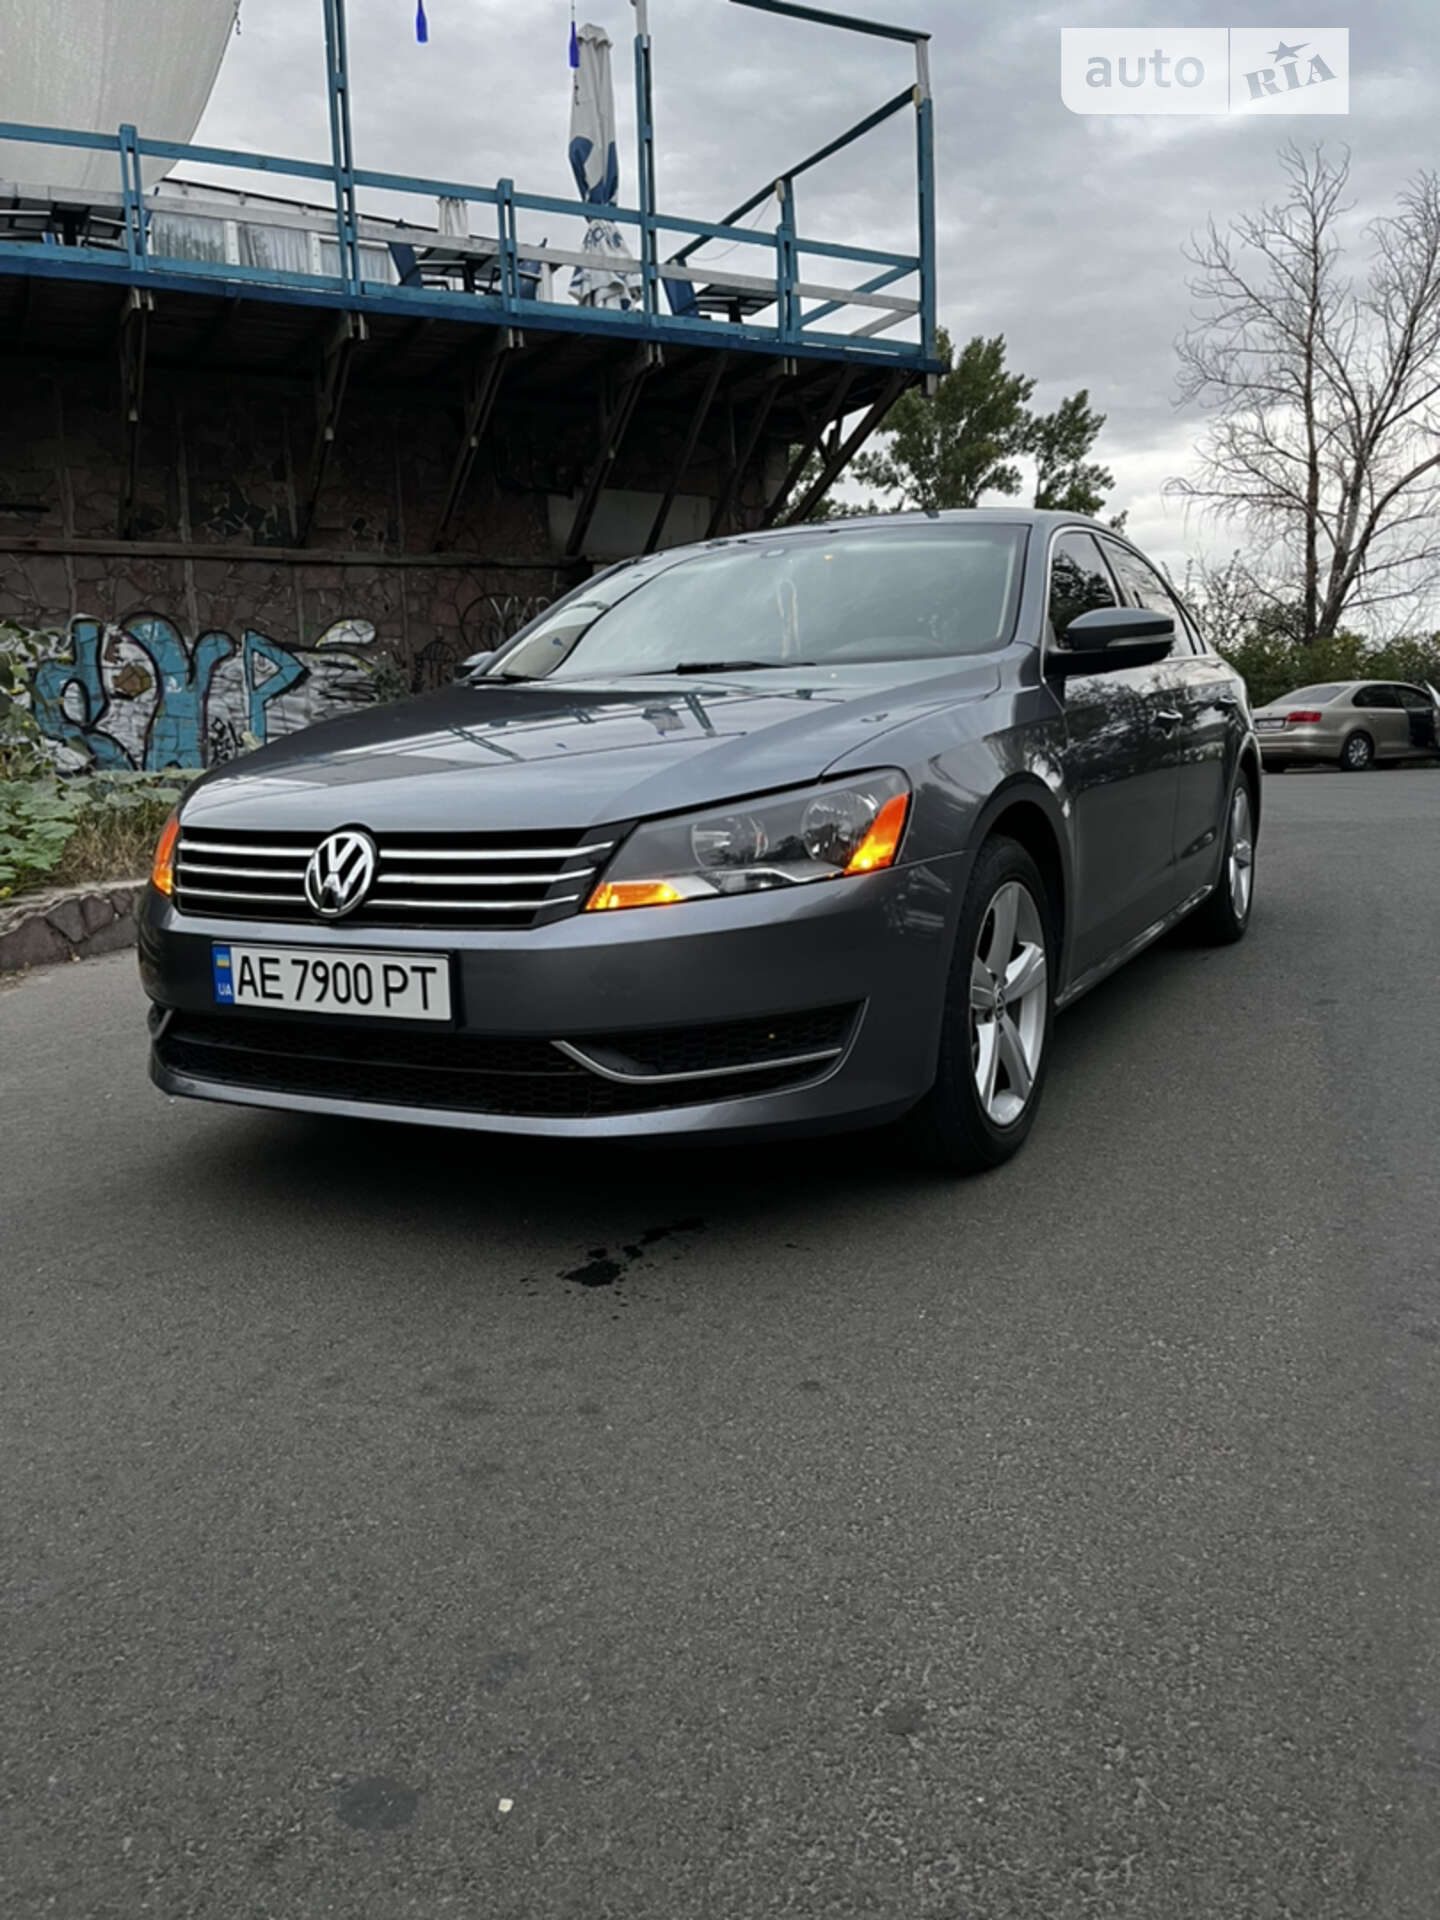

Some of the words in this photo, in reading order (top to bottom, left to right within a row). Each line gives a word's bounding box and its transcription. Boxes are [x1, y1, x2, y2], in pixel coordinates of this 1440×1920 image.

[217, 983, 233, 996] UA
[238, 955, 284, 1000] AE
[291, 959, 373, 1006] 7900
[382, 964, 437, 1010] PT
